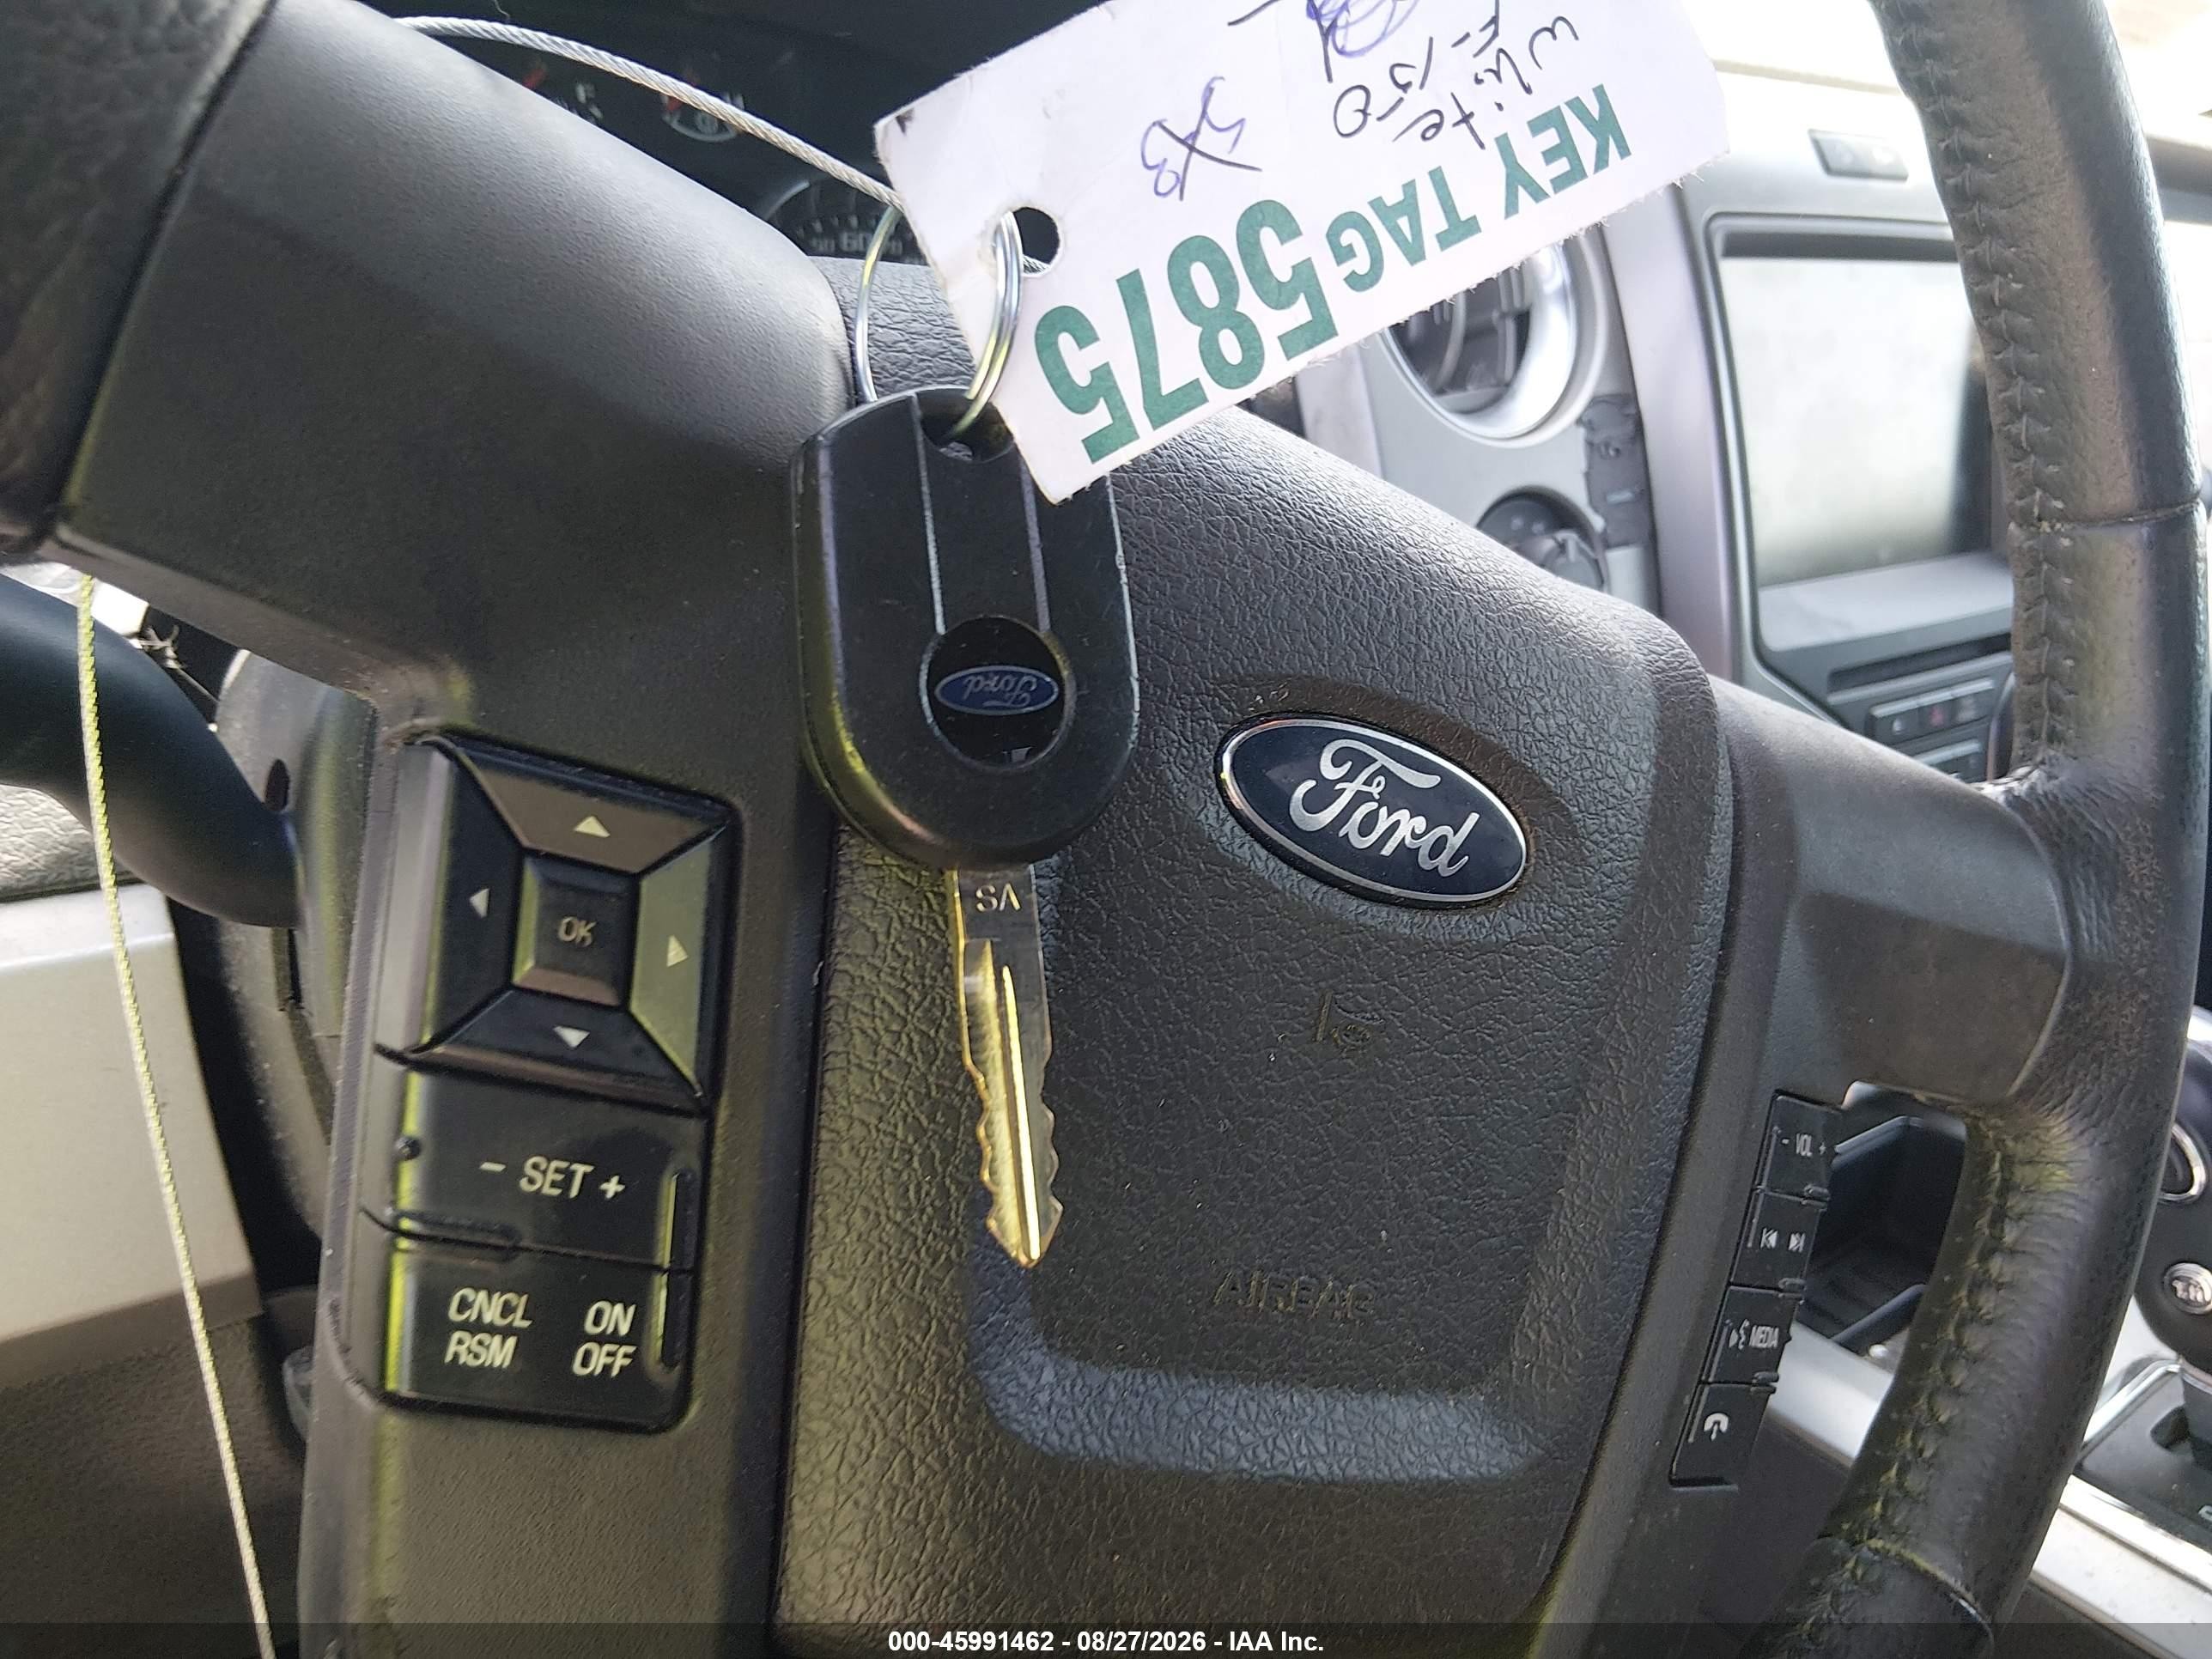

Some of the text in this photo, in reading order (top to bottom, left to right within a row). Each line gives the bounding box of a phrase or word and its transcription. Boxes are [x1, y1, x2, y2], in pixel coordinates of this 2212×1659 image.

[1034, 83, 1632, 465] KEY TAG 5875
[962, 672, 1037, 708] Ford
[1289, 738, 1480, 878] Ford
[975, 883, 1022, 912] VS
[556, 915, 596, 946] OK
[1796, 1133, 1814, 1158] VOL
[519, 1155, 594, 1200] SET
[447, 1287, 533, 1328] CNCL
[584, 1300, 637, 1336] ON
[444, 1331, 519, 1369] RSM
[1749, 1324, 1778, 1349] MEDIA
[572, 1342, 637, 1377] OFF
